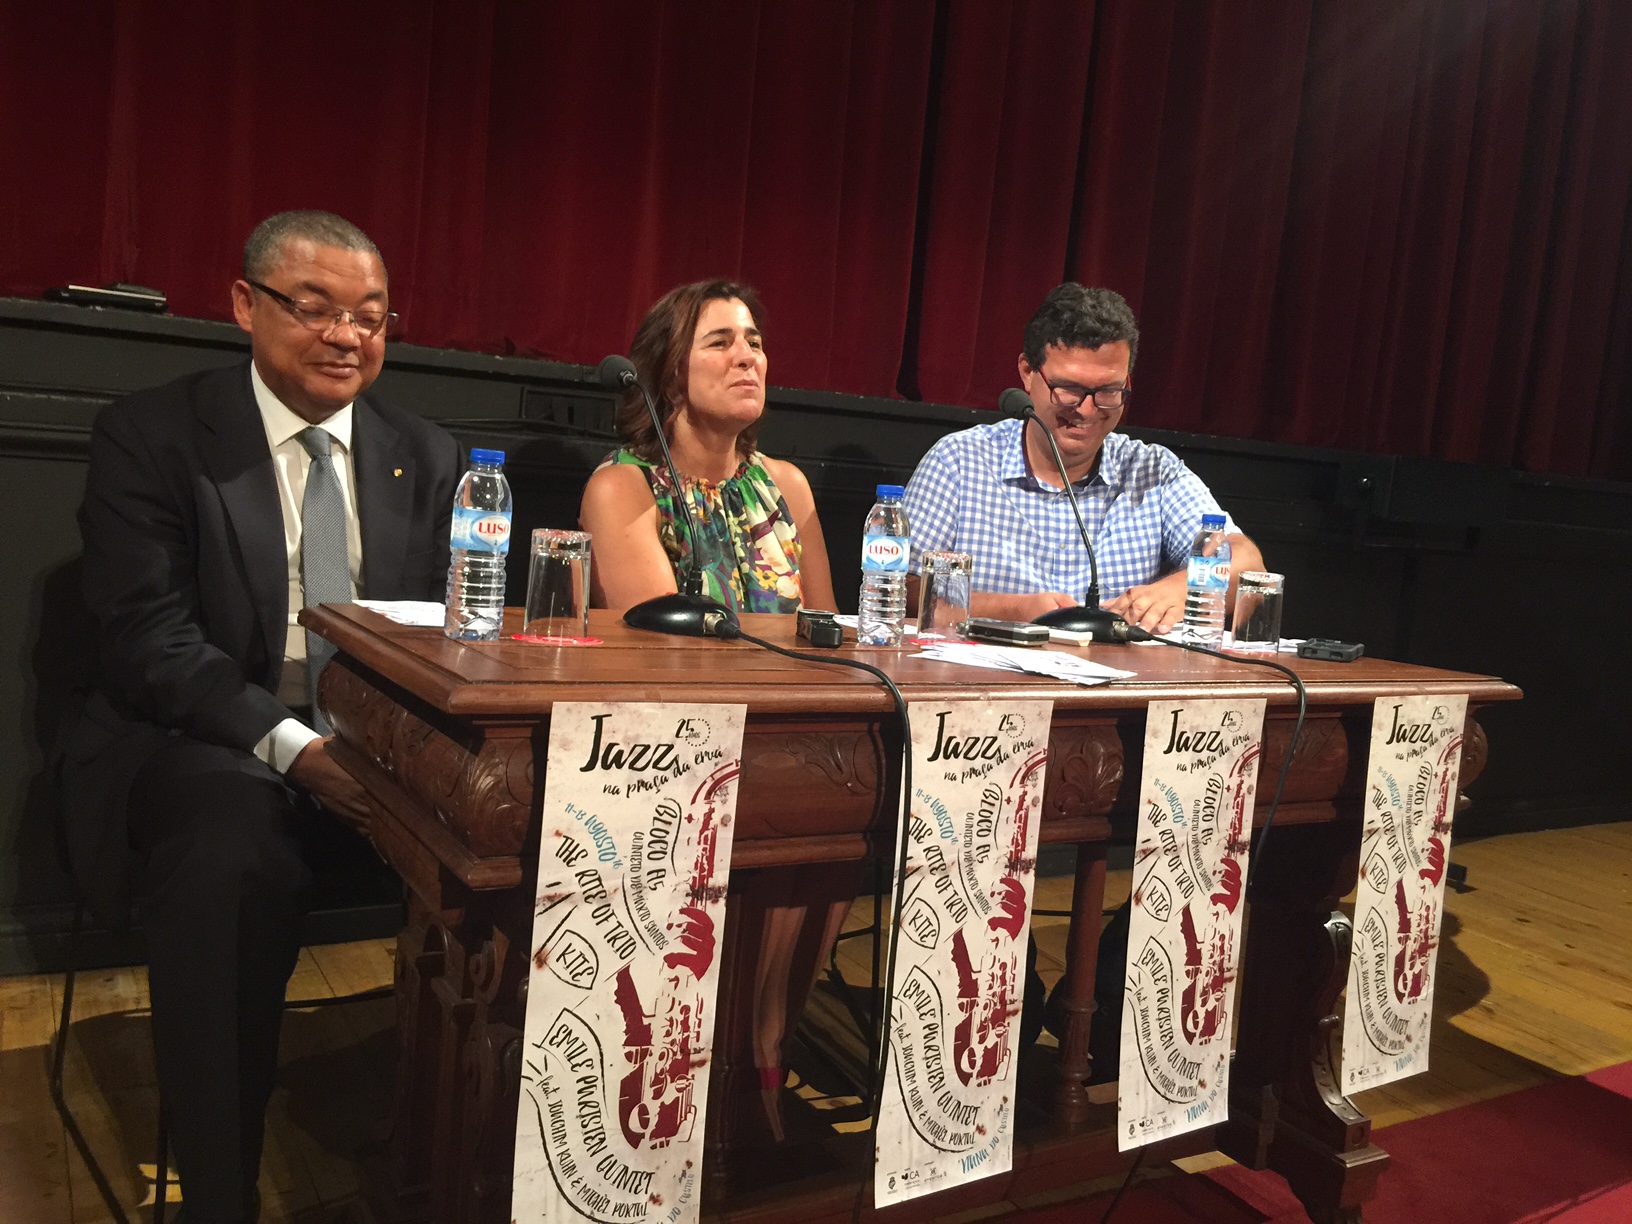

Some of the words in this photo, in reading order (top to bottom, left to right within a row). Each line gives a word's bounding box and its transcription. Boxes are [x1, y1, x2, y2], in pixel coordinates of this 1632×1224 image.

[478, 522, 509, 534] LUSO
[869, 545, 899, 555] LUSO
[675, 718, 696, 738] 25
[927, 711, 998, 762] Jazz
[998, 714, 1013, 731] 25
[1163, 709, 1221, 754] Jazz
[1385, 704, 1432, 745] Jazz
[579, 713, 676, 772] Jazz
[1176, 763, 1187, 772] na
[1190, 755, 1217, 774] praça
[1218, 739, 1230, 757] da
[1395, 753, 1404, 761] na
[1406, 746, 1428, 762] praça
[1429, 731, 1439, 748] da
[603, 783, 621, 795] na
[626, 775, 669, 798] praça
[672, 754, 691, 779] da
[944, 771, 957, 782] na
[962, 764, 994, 784] praça
[996, 745, 1010, 766] da
[1201, 777, 1222, 823] BLOCO
[1372, 788, 1388, 810] THE
[1414, 766, 1431, 806] BLOCO
[930, 797, 953, 840] AGOSTO
[976, 788, 1000, 838] BLOCO
[1147, 803, 1168, 828] THE
[1381, 811, 1395, 835] RITE
[584, 814, 617, 862] AGOSTO
[646, 804, 678, 861] BLOCO
[909, 816, 933, 844] THE
[963, 812, 975, 848] QUINTETO
[1159, 829, 1178, 856] RITE
[1387, 834, 1400, 850] OF
[555, 835, 588, 867] THE
[923, 844, 946, 876] RITE
[975, 844, 991, 864] A5
[1168, 855, 1183, 873] OF
[1392, 847, 1407, 874] TRIO
[575, 868, 608, 904] RITE
[629, 831, 645, 872] QUINTETO
[644, 920, 670, 950] SANTOS
[646, 868, 667, 891] A5
[934, 874, 954, 895] OF
[1174, 868, 1195, 899] TRIO
[1370, 862, 1387, 889] KITE
[591, 902, 618, 926] OF
[943, 889, 969, 924] TRIO
[1146, 885, 1169, 916] KITE
[603, 920, 637, 960] TRIO
[908, 908, 937, 943] KITE
[556, 943, 594, 982] KITE
[1364, 917, 1385, 951] EMILE
[1382, 1007, 1410, 1035] QUINTET
[1141, 948, 1168, 986] EMILE
[1157, 988, 1175, 1051] PARISIEN
[1167, 1048, 1202, 1080] QUINTET
[903, 978, 936, 1020] EMILE
[922, 1023, 946, 1094] PARISIEN
[936, 1090, 981, 1126] QUINTET
[549, 1023, 595, 1073] EMILE
[576, 1075, 608, 1158] PARISIEN
[596, 1153, 655, 1195] QUINTET
[570, 1176, 584, 1190] &
[909, 1170, 920, 1180] CA
